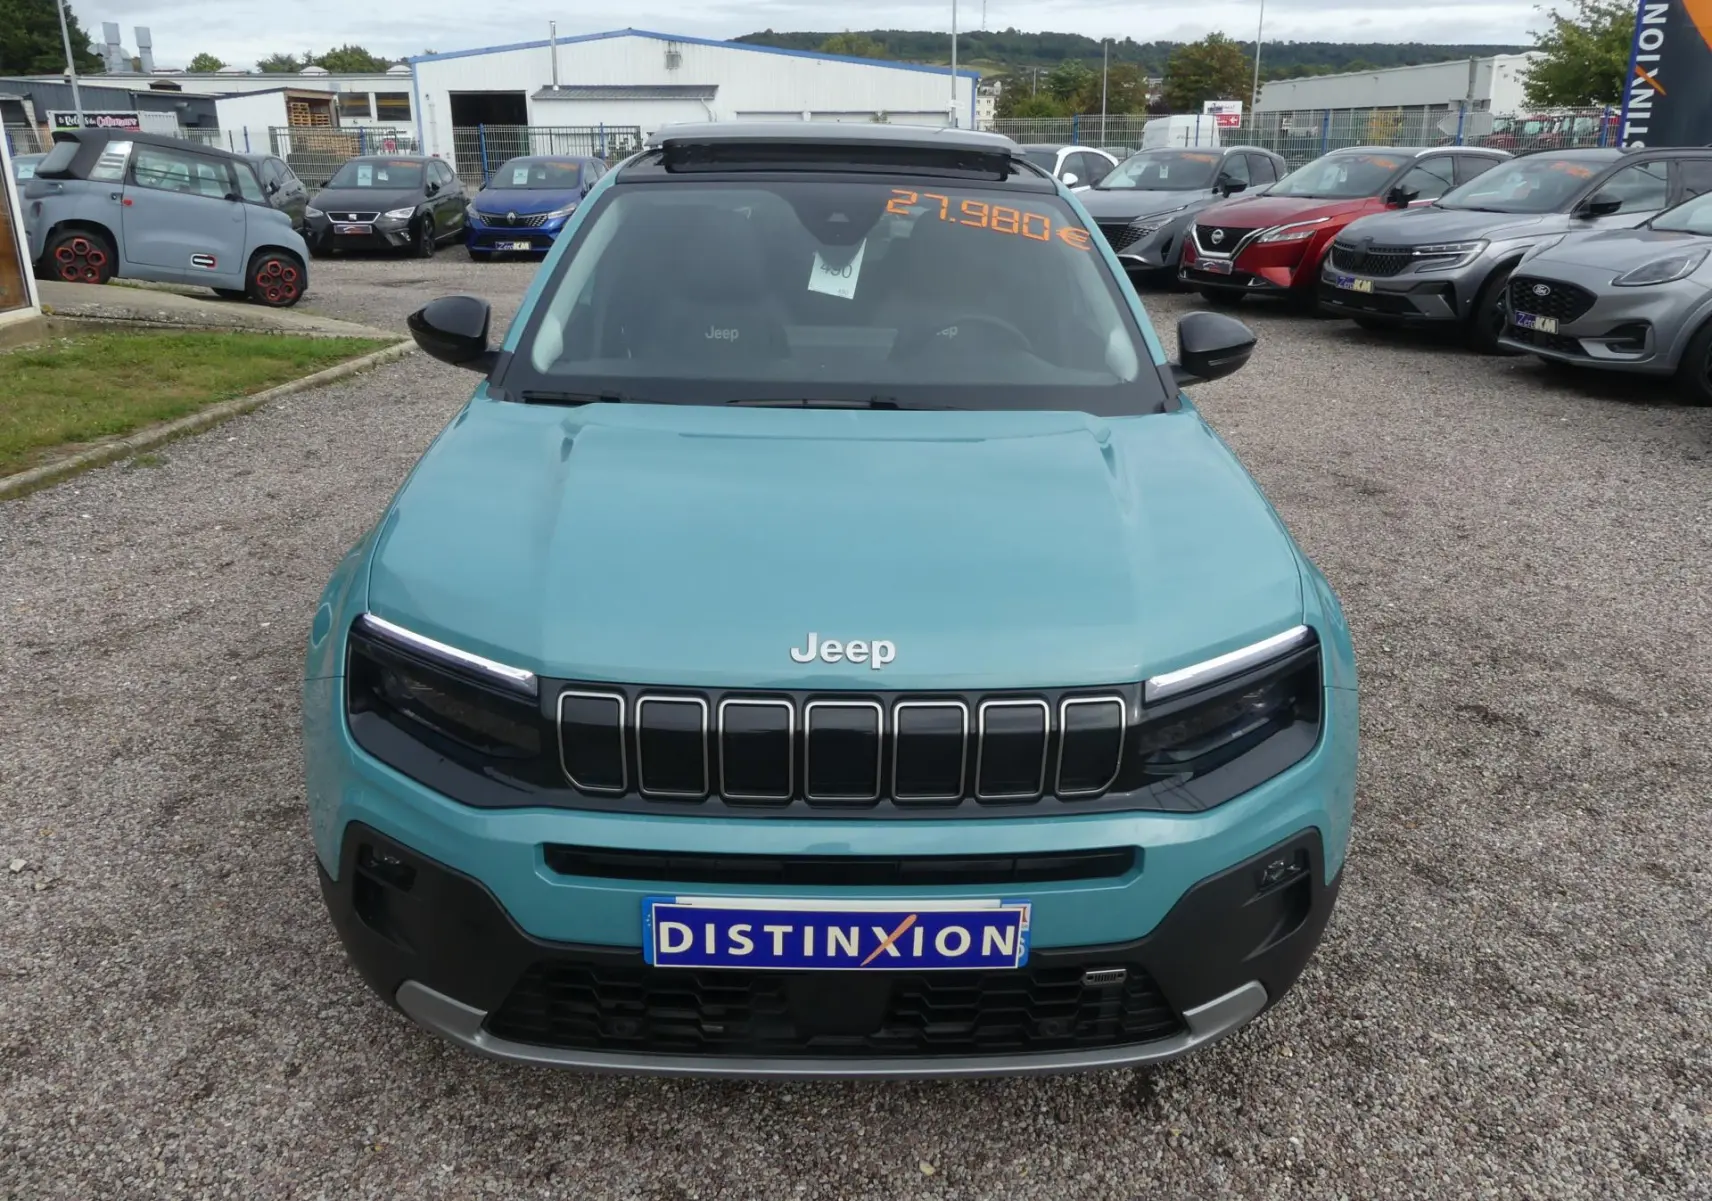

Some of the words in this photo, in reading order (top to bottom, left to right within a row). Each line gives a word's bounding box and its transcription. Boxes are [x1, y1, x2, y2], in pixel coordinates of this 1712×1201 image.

[704, 325, 739, 343] Jeep
[936, 326, 958, 340] ep
[790, 632, 896, 670] Jeep
[659, 914, 1016, 967] DISTINXION
